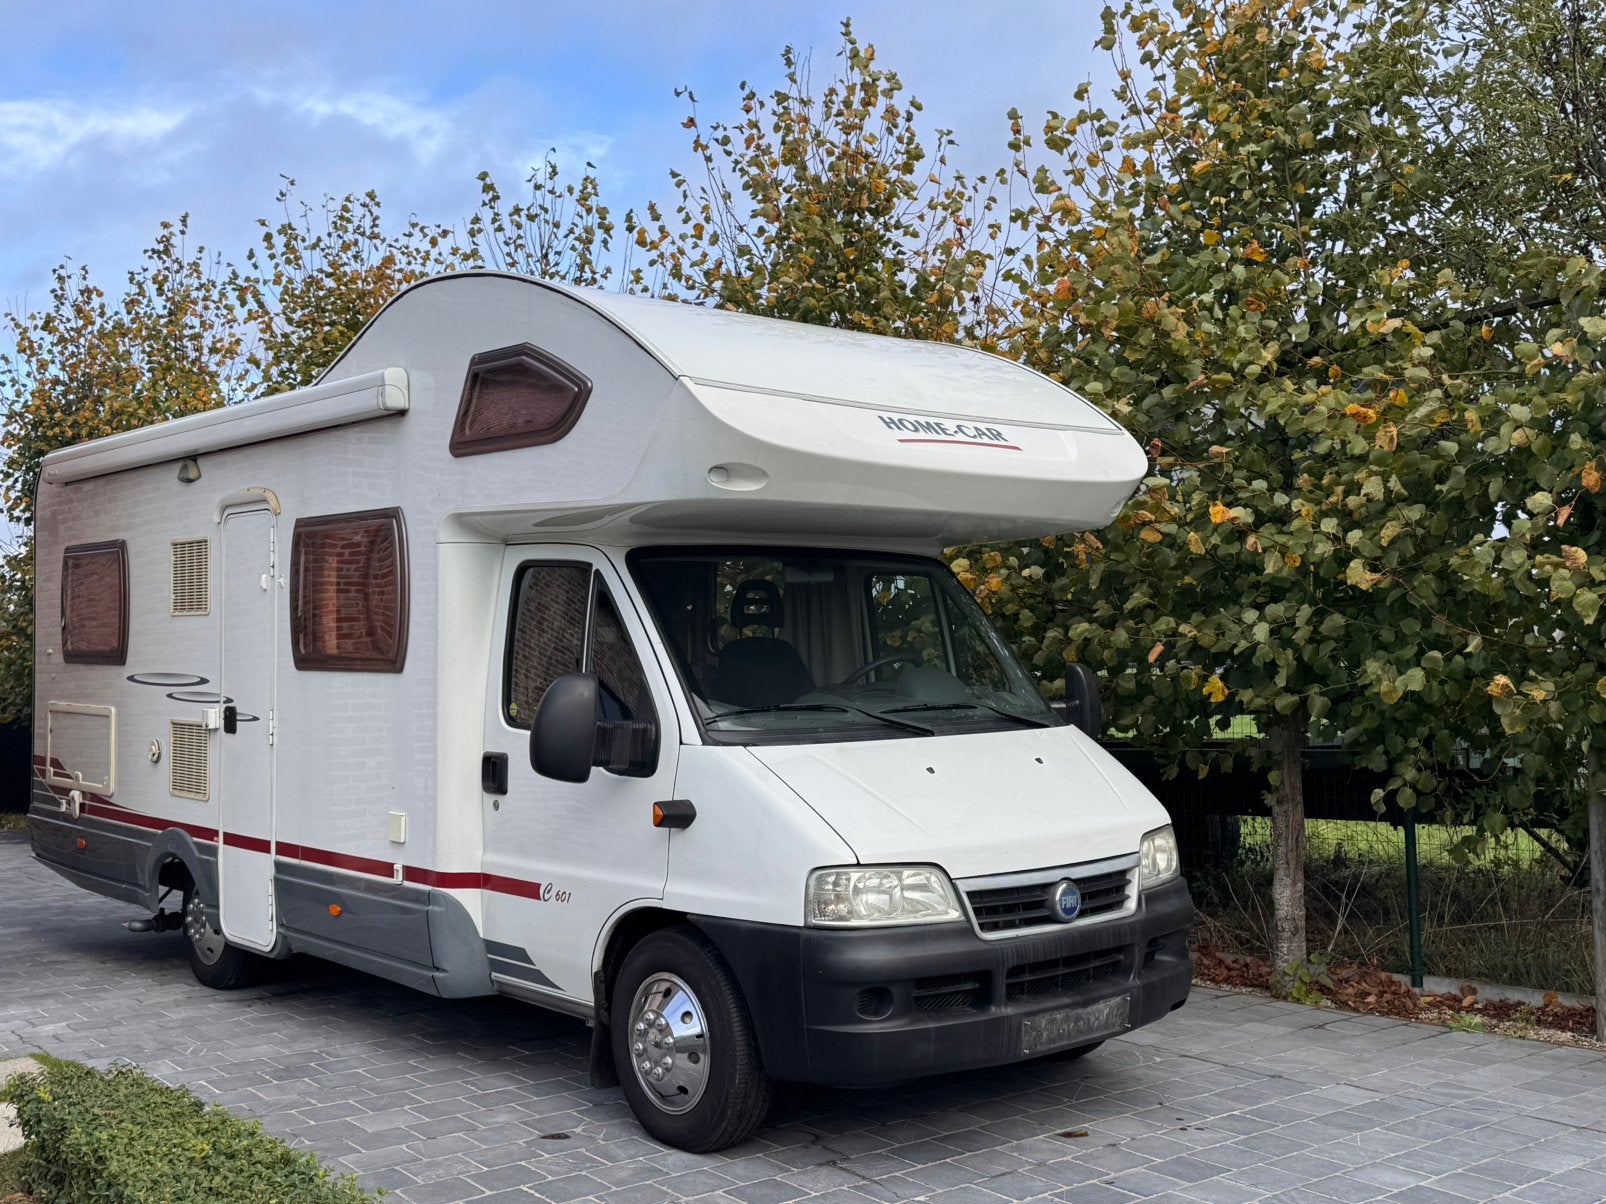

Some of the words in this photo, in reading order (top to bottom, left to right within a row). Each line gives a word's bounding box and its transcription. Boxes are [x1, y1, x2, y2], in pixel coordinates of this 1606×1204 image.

[542, 882, 553, 902] C
[555, 890, 571, 904] 601
[1061, 895, 1077, 909] FIAT
